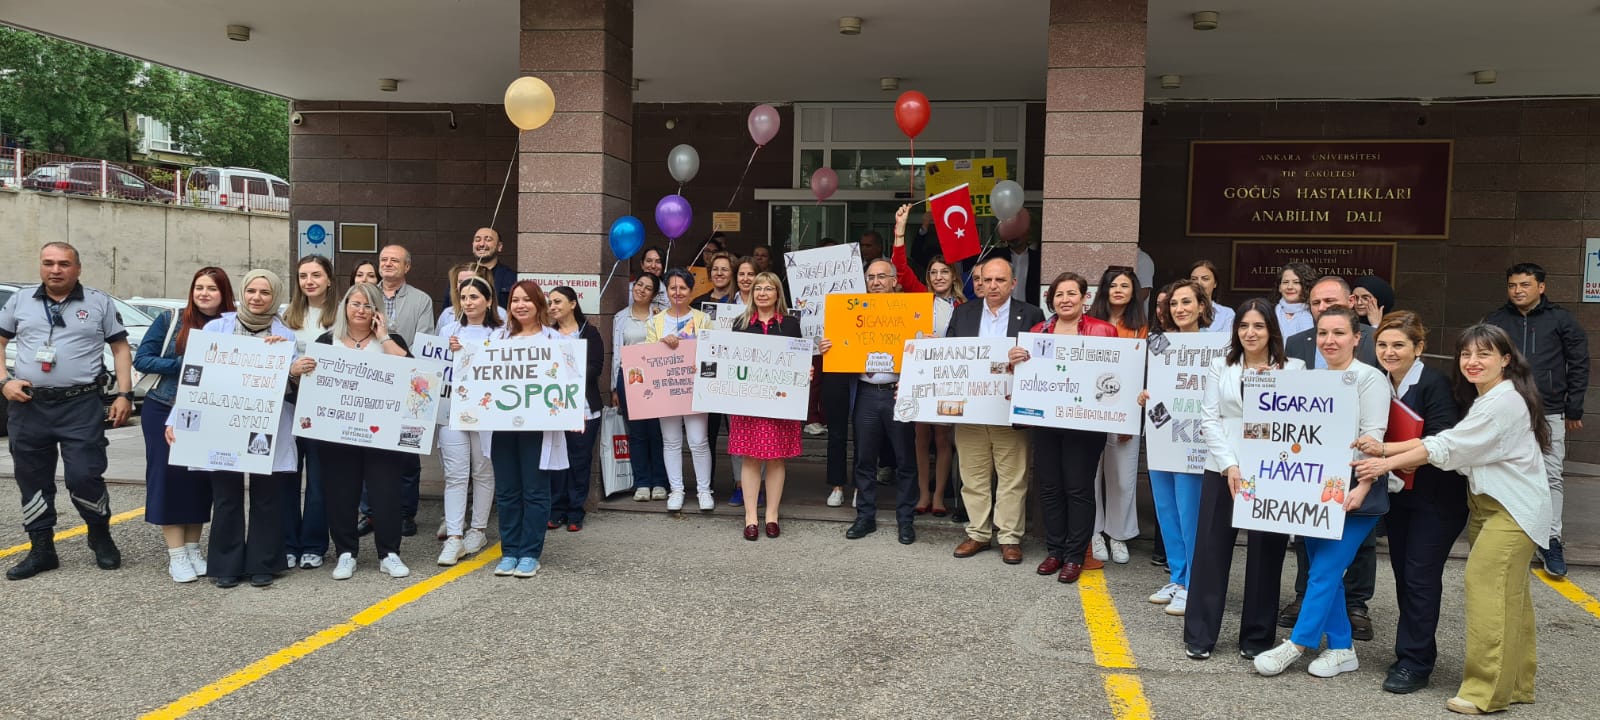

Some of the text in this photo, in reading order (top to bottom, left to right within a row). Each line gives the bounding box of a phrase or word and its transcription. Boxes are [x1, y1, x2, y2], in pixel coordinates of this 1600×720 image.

[1312, 151, 1381, 161] ÜNİVERSİTESİ
[1304, 169, 1356, 178] FAKÜLTESİ
[1296, 187, 1412, 200] HASTALIKLARI
[1251, 209, 1382, 223] ANABİLİM DALI
[1310, 266, 1375, 276] ASTALIKLAR
[205, 342, 285, 370] ÜRÜNLER
[485, 346, 551, 361] TÜTÜN
[732, 346, 771, 364] ADIM
[775, 351, 797, 367] AT
[914, 345, 992, 361] DUMANSIZ
[1055, 340, 1121, 363] E-SİGARA
[242, 374, 277, 388] YENİ
[318, 357, 394, 384] TÜTÜNLE
[933, 364, 969, 379] HAVA
[1020, 372, 1080, 394] NİKOTİN
[189, 392, 276, 413] YALANLAR
[495, 383, 579, 411] SPOR
[1258, 391, 1333, 413] SİGARAYI
[1055, 404, 1127, 423] BAĞIMLILIK
[1271, 421, 1323, 446] BIRAK
[1259, 459, 1324, 484] HAYATI
[1252, 497, 1330, 530] BIRAKMA
